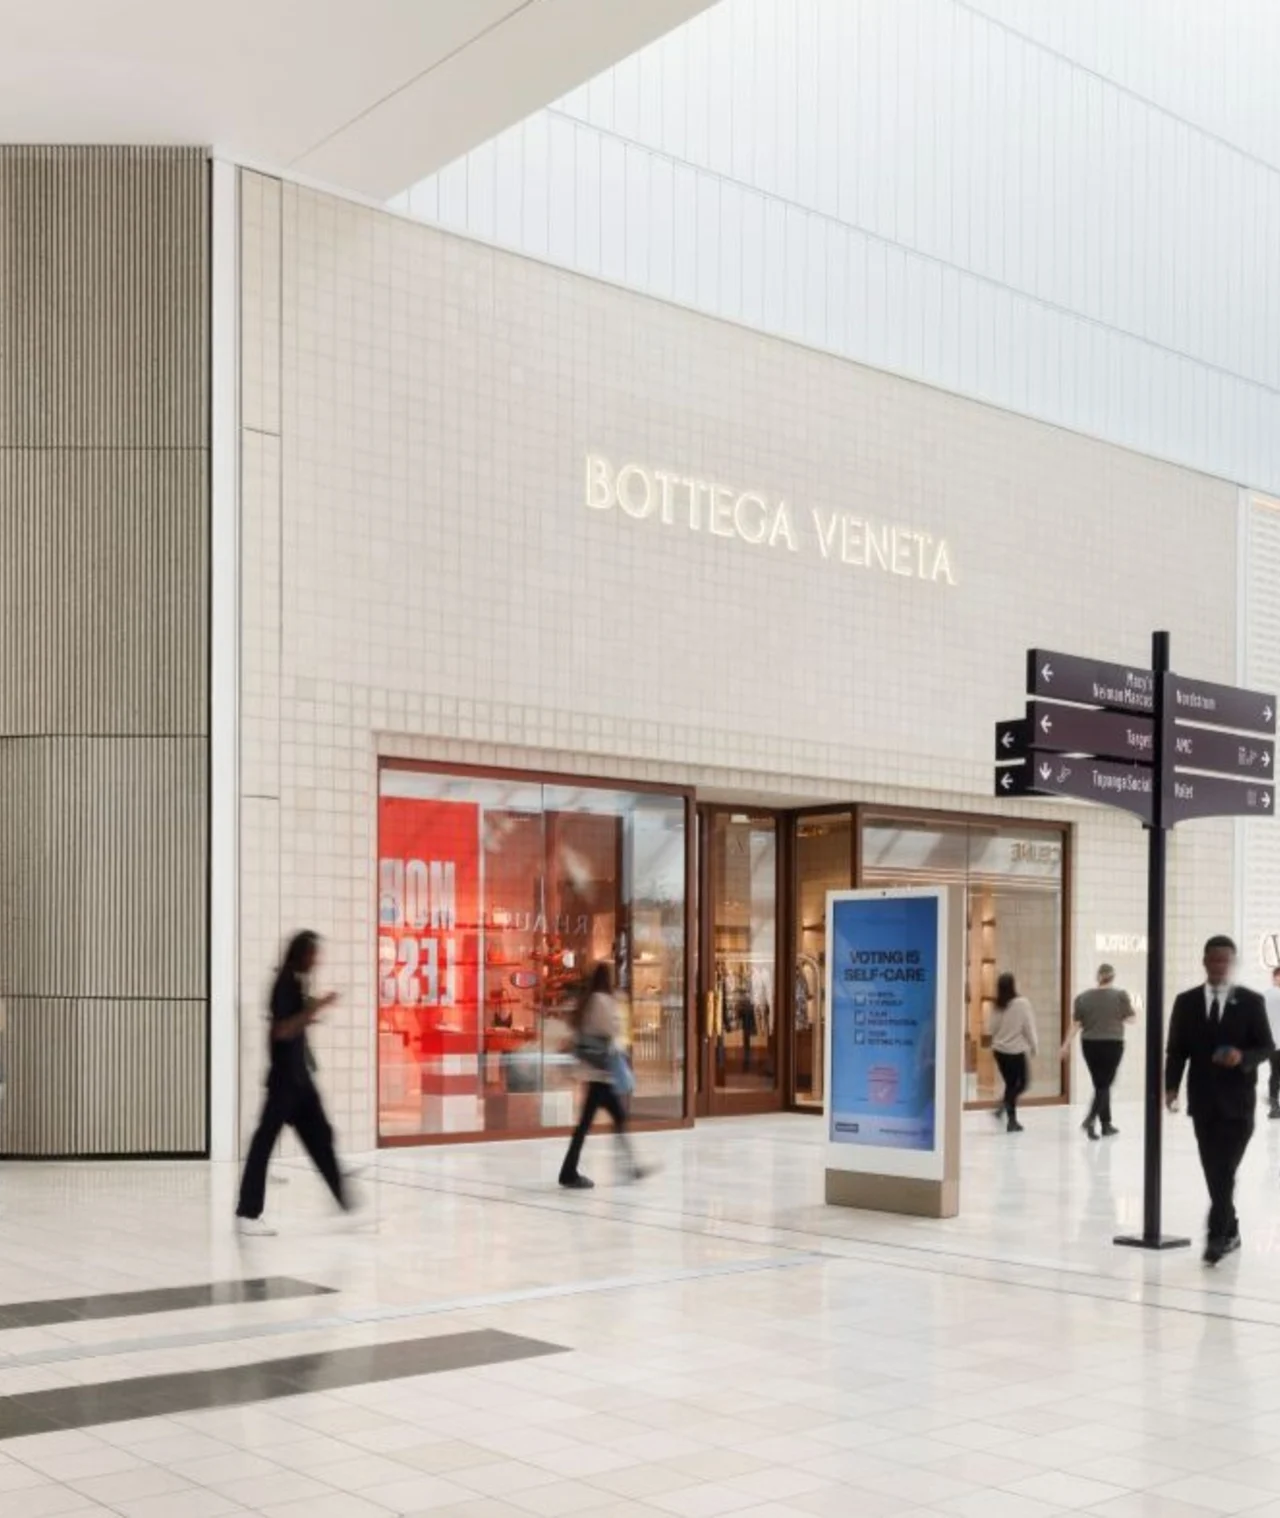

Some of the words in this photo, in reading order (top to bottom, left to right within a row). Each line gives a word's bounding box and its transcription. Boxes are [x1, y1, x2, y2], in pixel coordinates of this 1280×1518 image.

[585, 453, 799, 552] BOTTEGA
[811, 506, 959, 586] VENETA
[1176, 690, 1216, 710] Nordstrom
[1175, 737, 1193, 754] AMC
[849, 950, 903, 965] VOTING
[906, 950, 922, 965] IS
[844, 967, 927, 982] SELF-CARE
